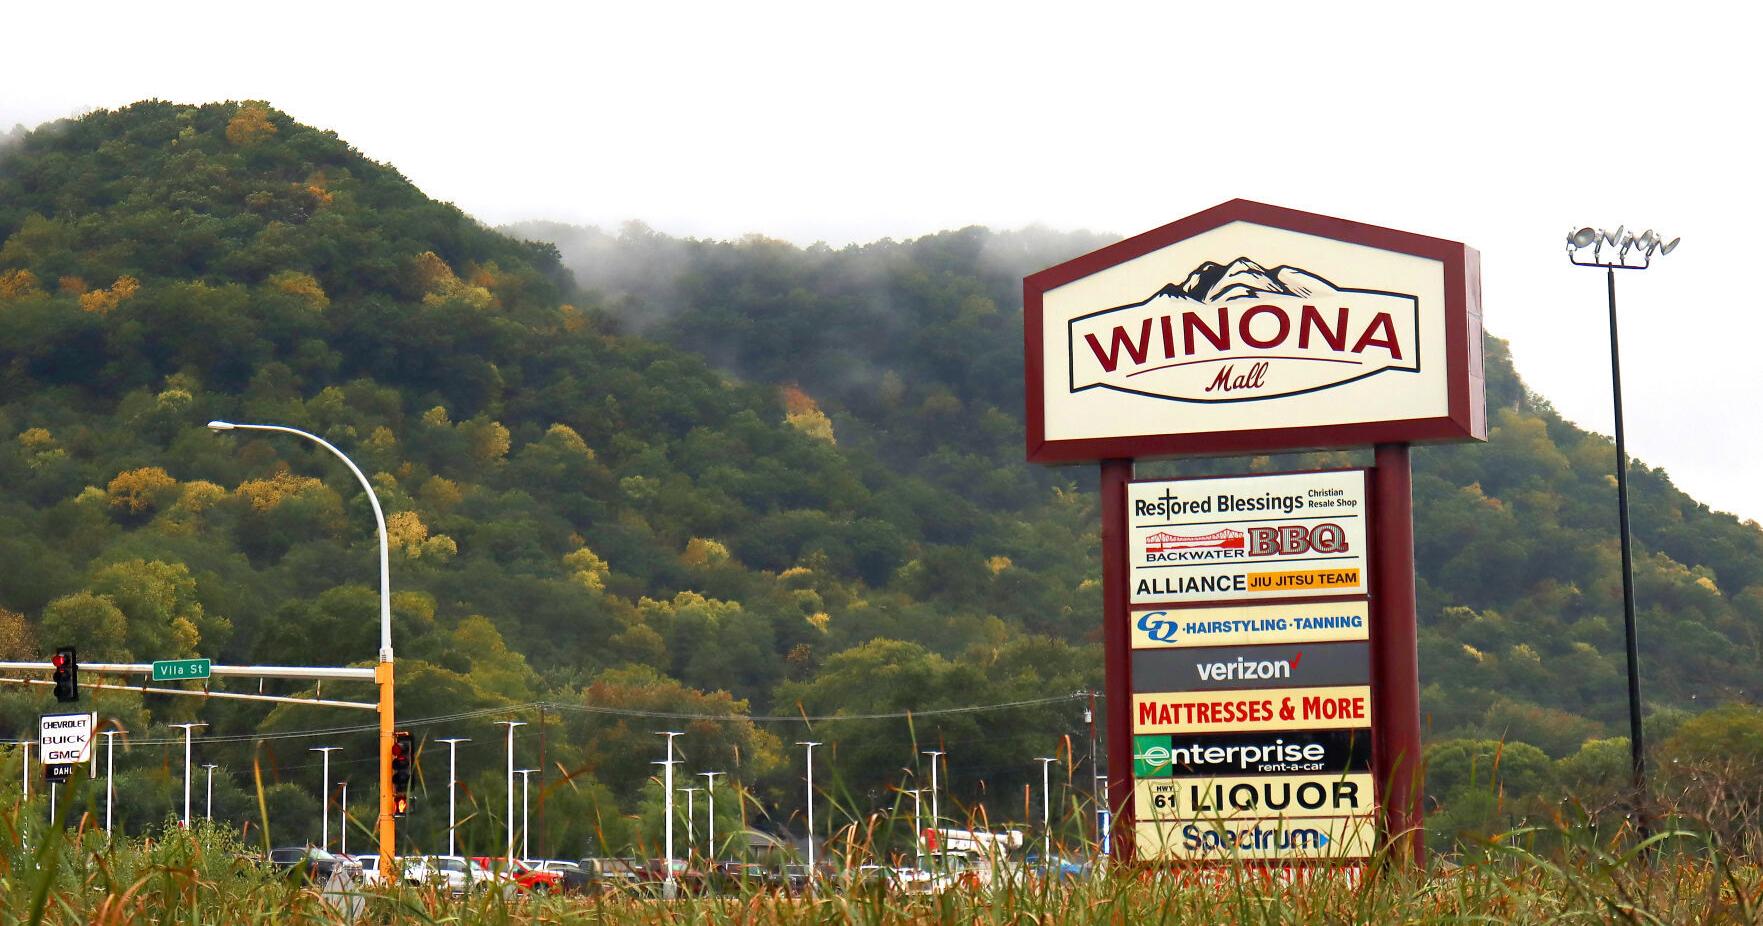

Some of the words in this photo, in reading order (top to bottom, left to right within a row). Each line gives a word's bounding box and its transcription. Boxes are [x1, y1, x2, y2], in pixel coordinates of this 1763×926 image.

[1084, 304, 1403, 373] WINONA
[1205, 361, 1269, 393] Mall
[1135, 488, 1212, 520] Restored
[1217, 492, 1304, 514] Blessings
[1308, 488, 1344, 497] Christian
[1308, 499, 1335, 508] Resale
[1337, 498, 1357, 508] Shop
[1146, 549, 1244, 562] BACKWATER
[1248, 523, 1349, 557] BBQ
[1136, 574, 1246, 595] ALLIANCE
[1250, 576, 1272, 587] JIU
[1276, 575, 1314, 586] JITSU
[1318, 573, 1357, 585] TEAM
[1137, 611, 1178, 643] GQ
[1186, 618, 1287, 634] HAIRSTYLING
[1294, 615, 1362, 630] TANNING
[190, 664, 203, 674] St
[1197, 656, 1290, 681] verizon
[1139, 700, 1273, 725] MATTRESSES
[1279, 697, 1295, 720] &
[1302, 696, 1365, 720] MORE
[43, 719, 87, 730] CHEVROLET
[42, 735, 86, 745] BUICK
[48, 750, 80, 760] GMC
[1143, 739, 1325, 769] enterprise
[1258, 762, 1325, 772] rent-a-car
[1154, 794, 1177, 808] 61
[1191, 781, 1359, 812] LIQUOR
[1182, 824, 1319, 852] Spectrum
